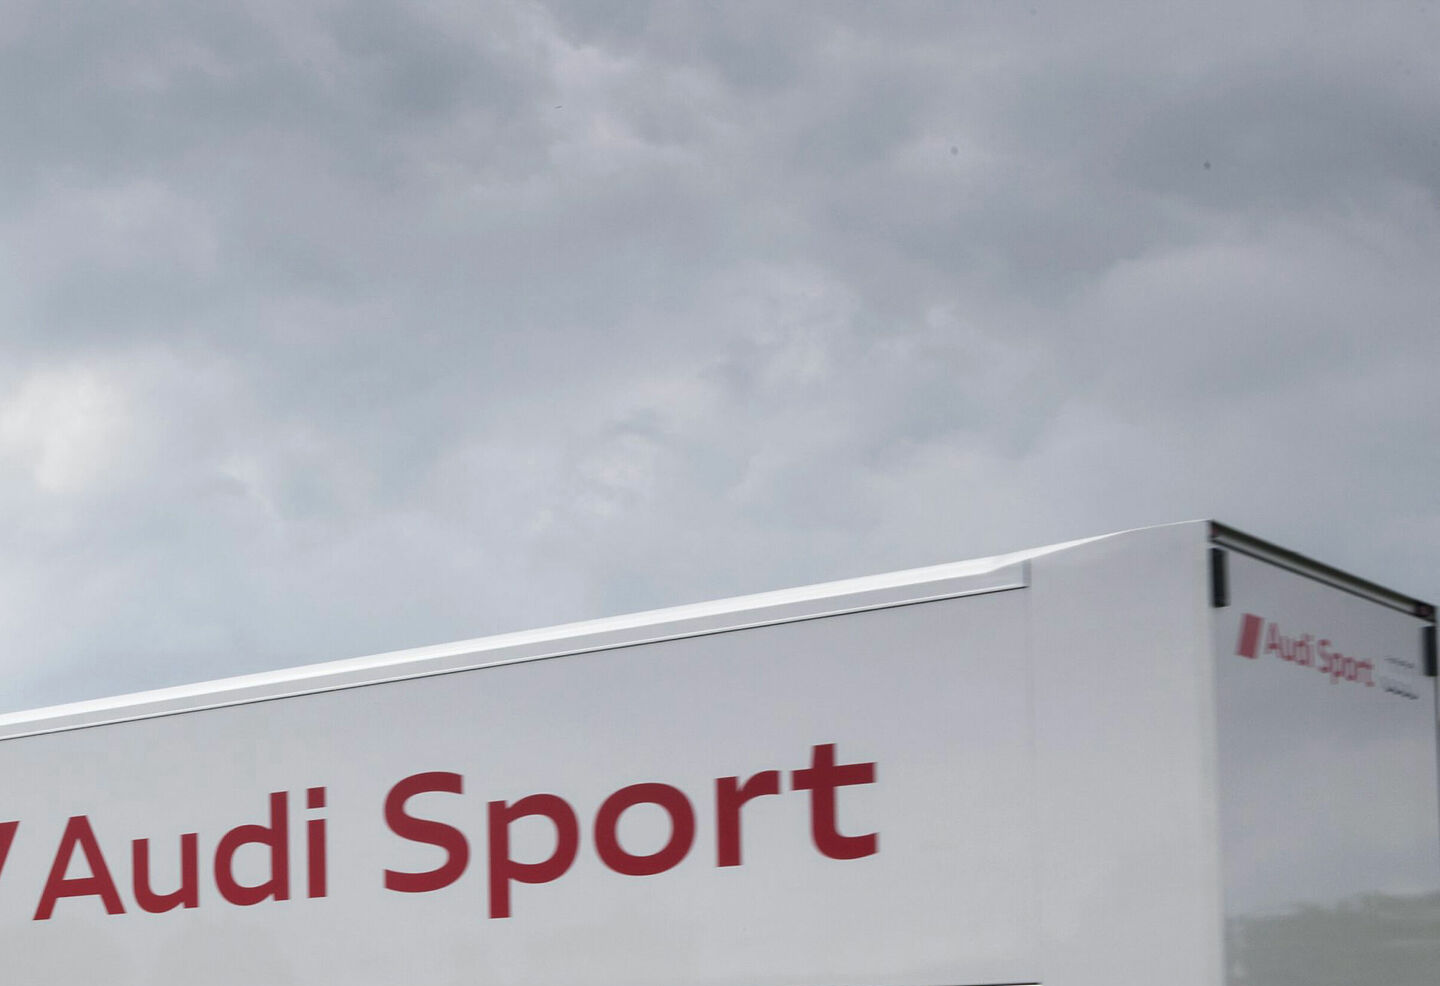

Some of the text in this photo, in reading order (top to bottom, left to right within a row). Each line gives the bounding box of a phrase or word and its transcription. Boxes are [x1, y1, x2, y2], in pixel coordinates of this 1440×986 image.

[1265, 623, 1315, 667] Audi
[32, 742, 880, 921] Audi Sport
